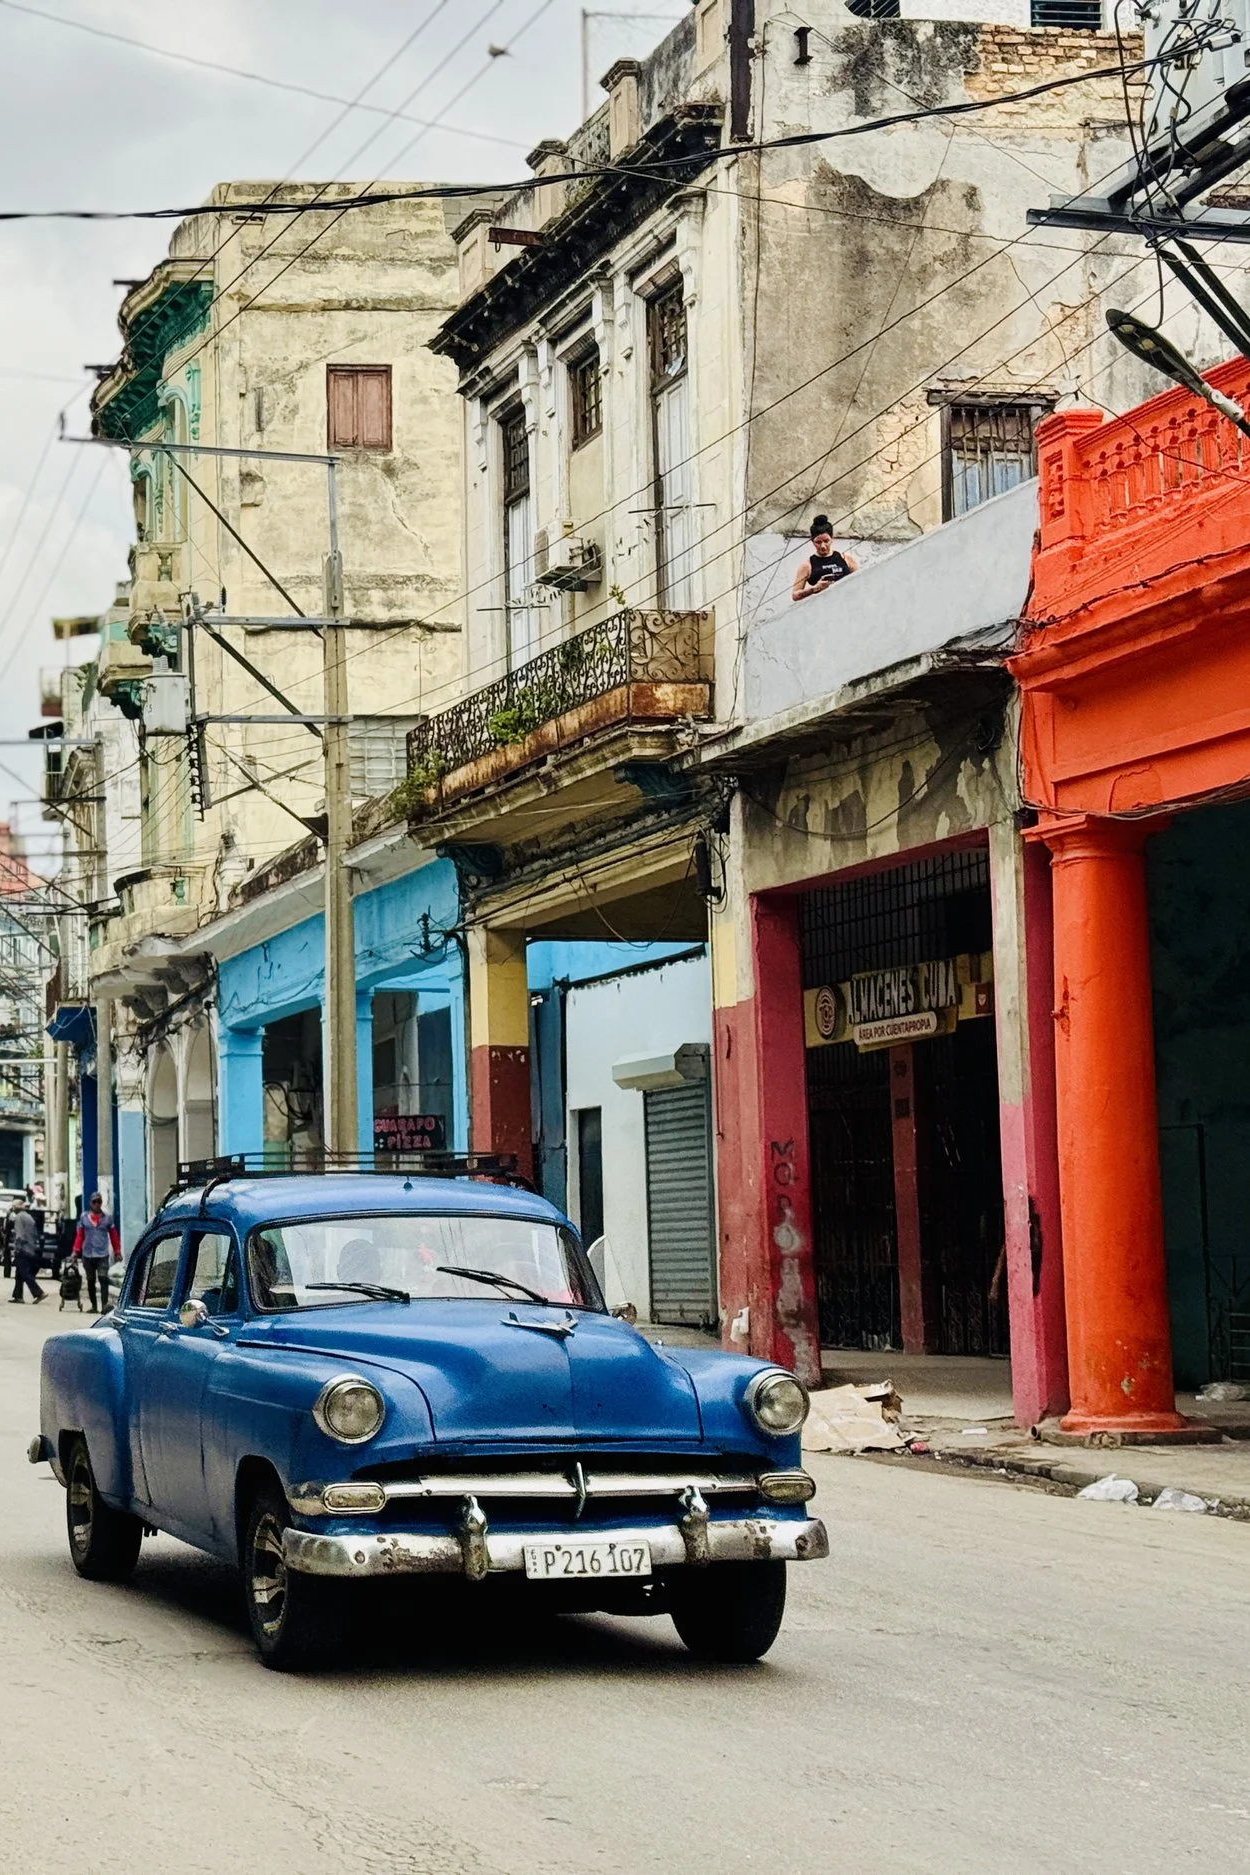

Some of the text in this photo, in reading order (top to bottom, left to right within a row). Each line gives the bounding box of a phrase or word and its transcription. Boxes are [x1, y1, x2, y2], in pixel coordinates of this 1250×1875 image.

[846, 967, 915, 1025] ALMACENES
[874, 1025, 886, 1037] POR
[374, 1117, 435, 1132] GUARAPO
[387, 1133, 431, 1149] PIZZA
